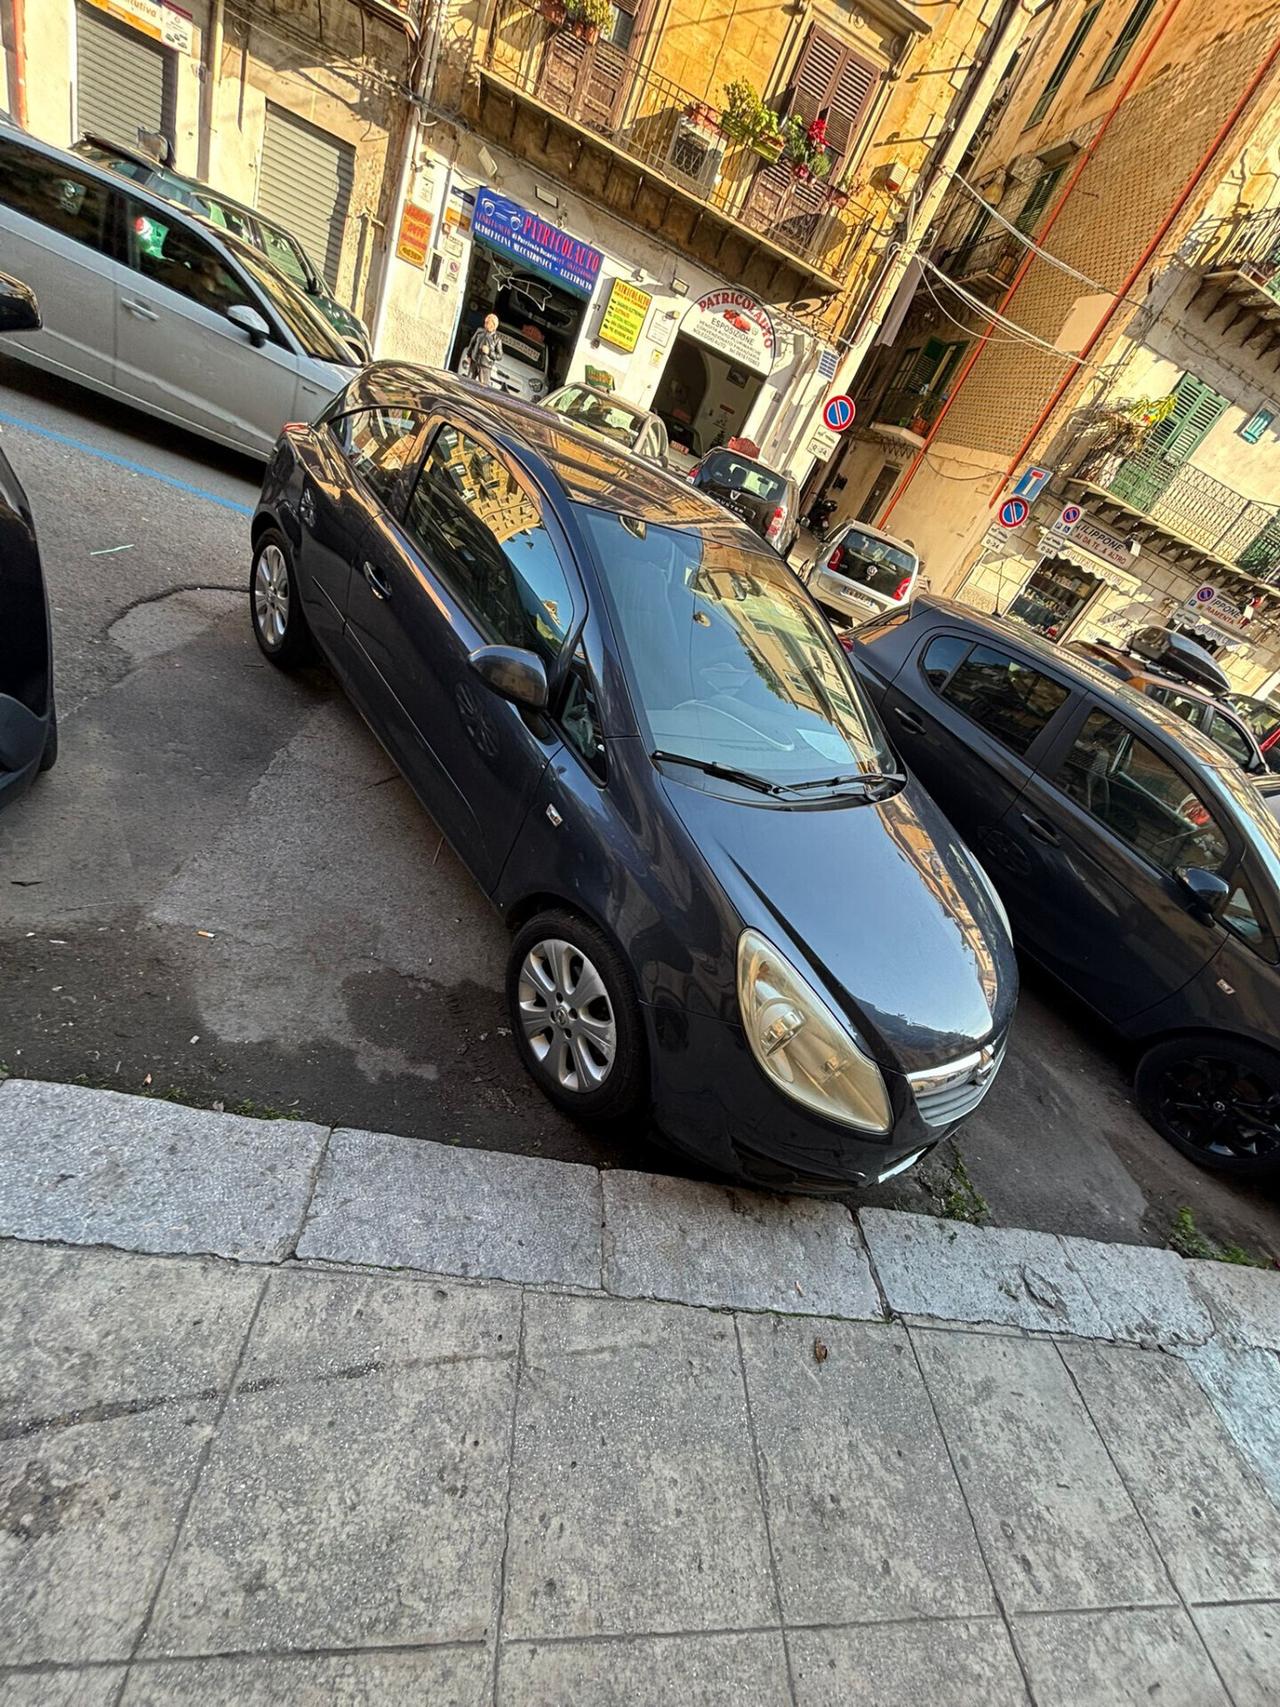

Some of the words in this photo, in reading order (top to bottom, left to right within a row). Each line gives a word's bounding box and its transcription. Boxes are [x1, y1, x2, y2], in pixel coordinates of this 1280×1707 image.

[128, 0, 156, 17] cutiva
[521, 215, 601, 272] PATRICOLAUTO
[698, 293, 773, 347] PATRICOLAUTO
[710, 317, 755, 345] ESPOSIZIONE
[1075, 523, 1124, 552] ILIPPONE
[1106, 549, 1127, 565] ALTRO
[1204, 604, 1234, 625] RAMENTA
[1210, 597, 1241, 619] IPPONE
